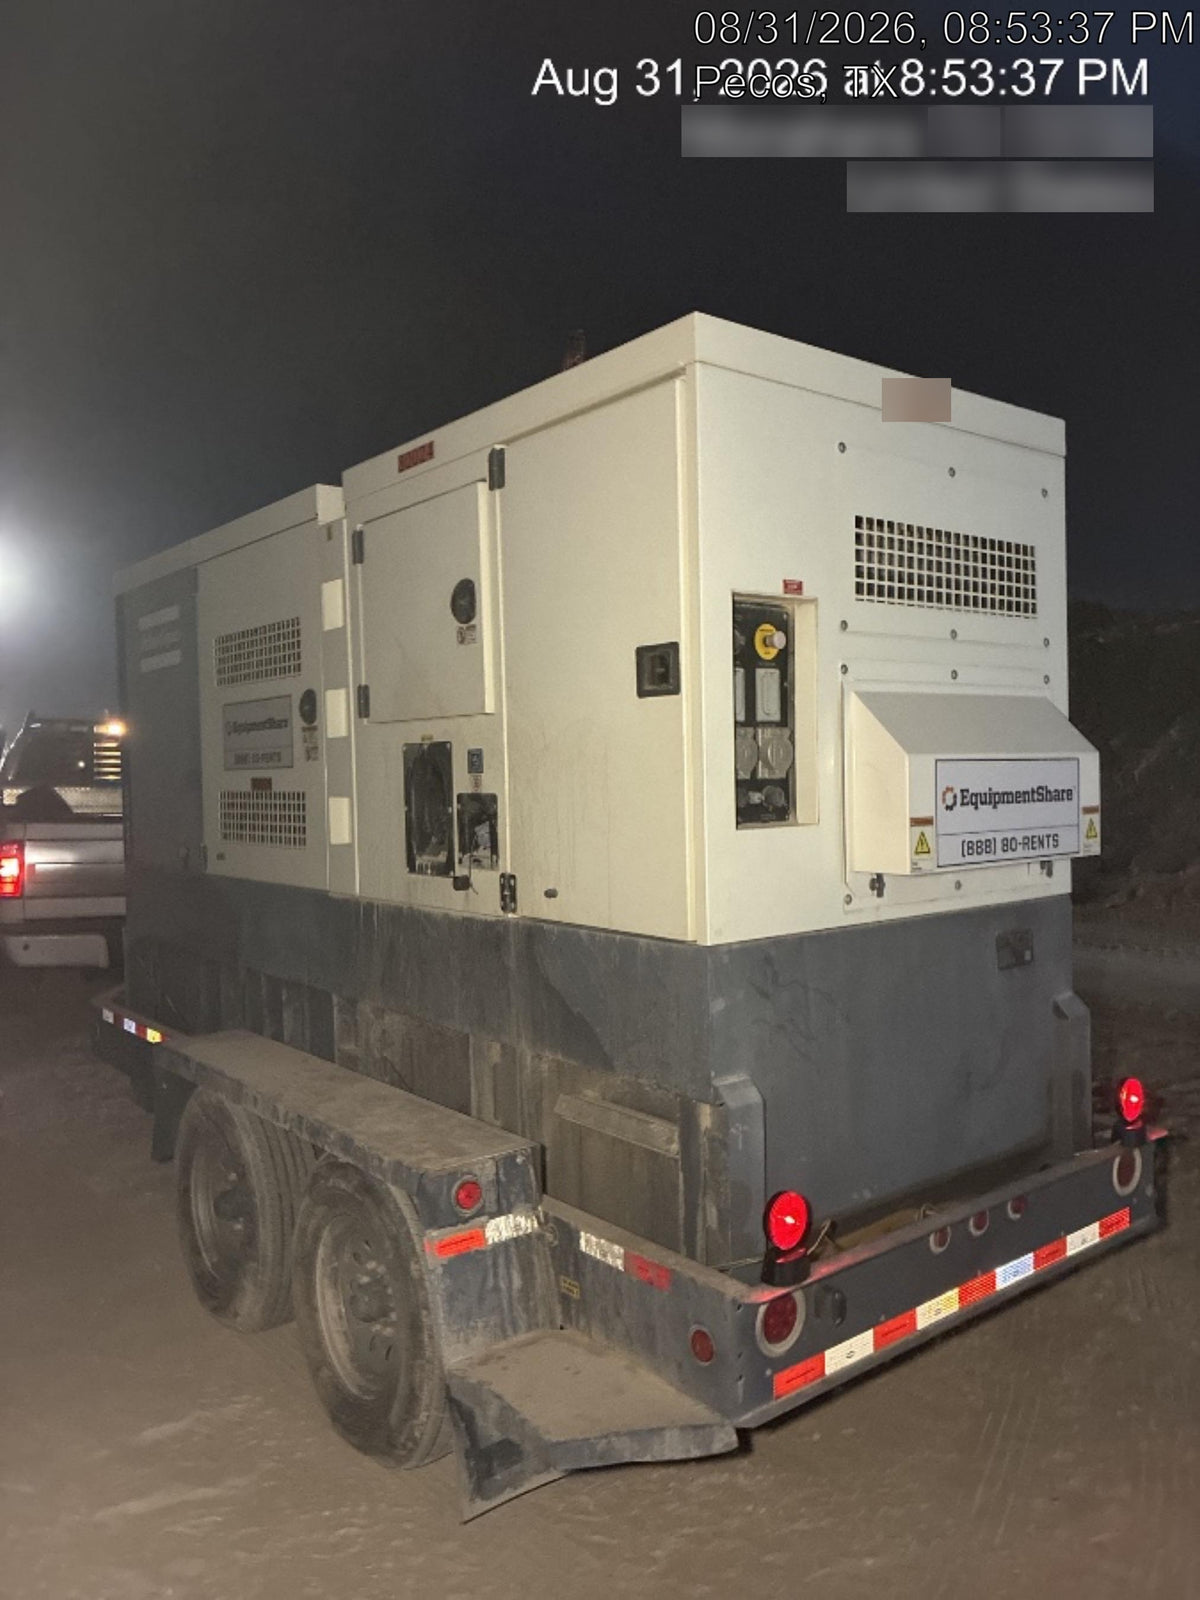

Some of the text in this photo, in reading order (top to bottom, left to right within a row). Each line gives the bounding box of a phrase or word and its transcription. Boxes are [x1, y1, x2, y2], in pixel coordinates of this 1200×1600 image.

[960, 785, 1073, 811] EquipmentShare
[961, 833, 1059, 858] (888) 80-RENTS
